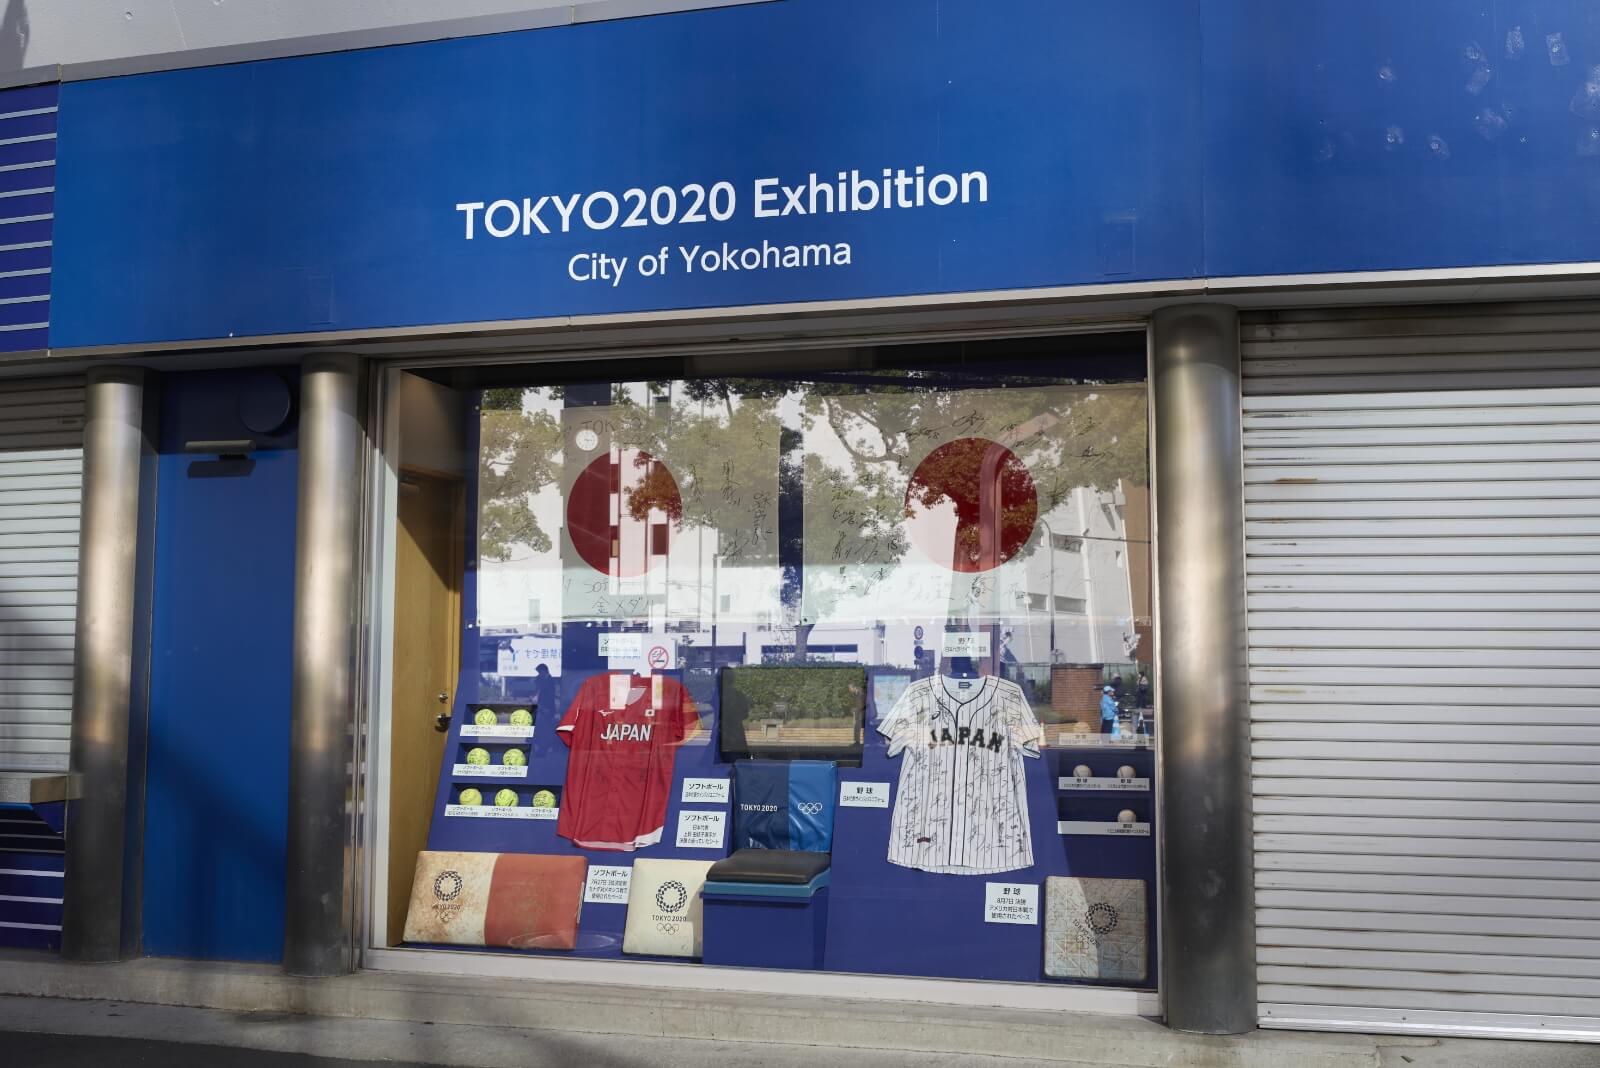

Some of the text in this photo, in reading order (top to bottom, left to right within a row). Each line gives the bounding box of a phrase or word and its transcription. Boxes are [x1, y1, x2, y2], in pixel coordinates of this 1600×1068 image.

[456, 165, 989, 240] TOKYO2020 Exhibition
[568, 239, 852, 287] City of Yokohama
[600, 723, 651, 741] JAPAN
[928, 726, 1005, 754] JAPAN
[856, 786, 874, 794] 野球
[740, 803, 778, 812] TOKYO 2020
[684, 815, 720, 823] ソフトボール
[651, 914, 672, 922] TOKYO
